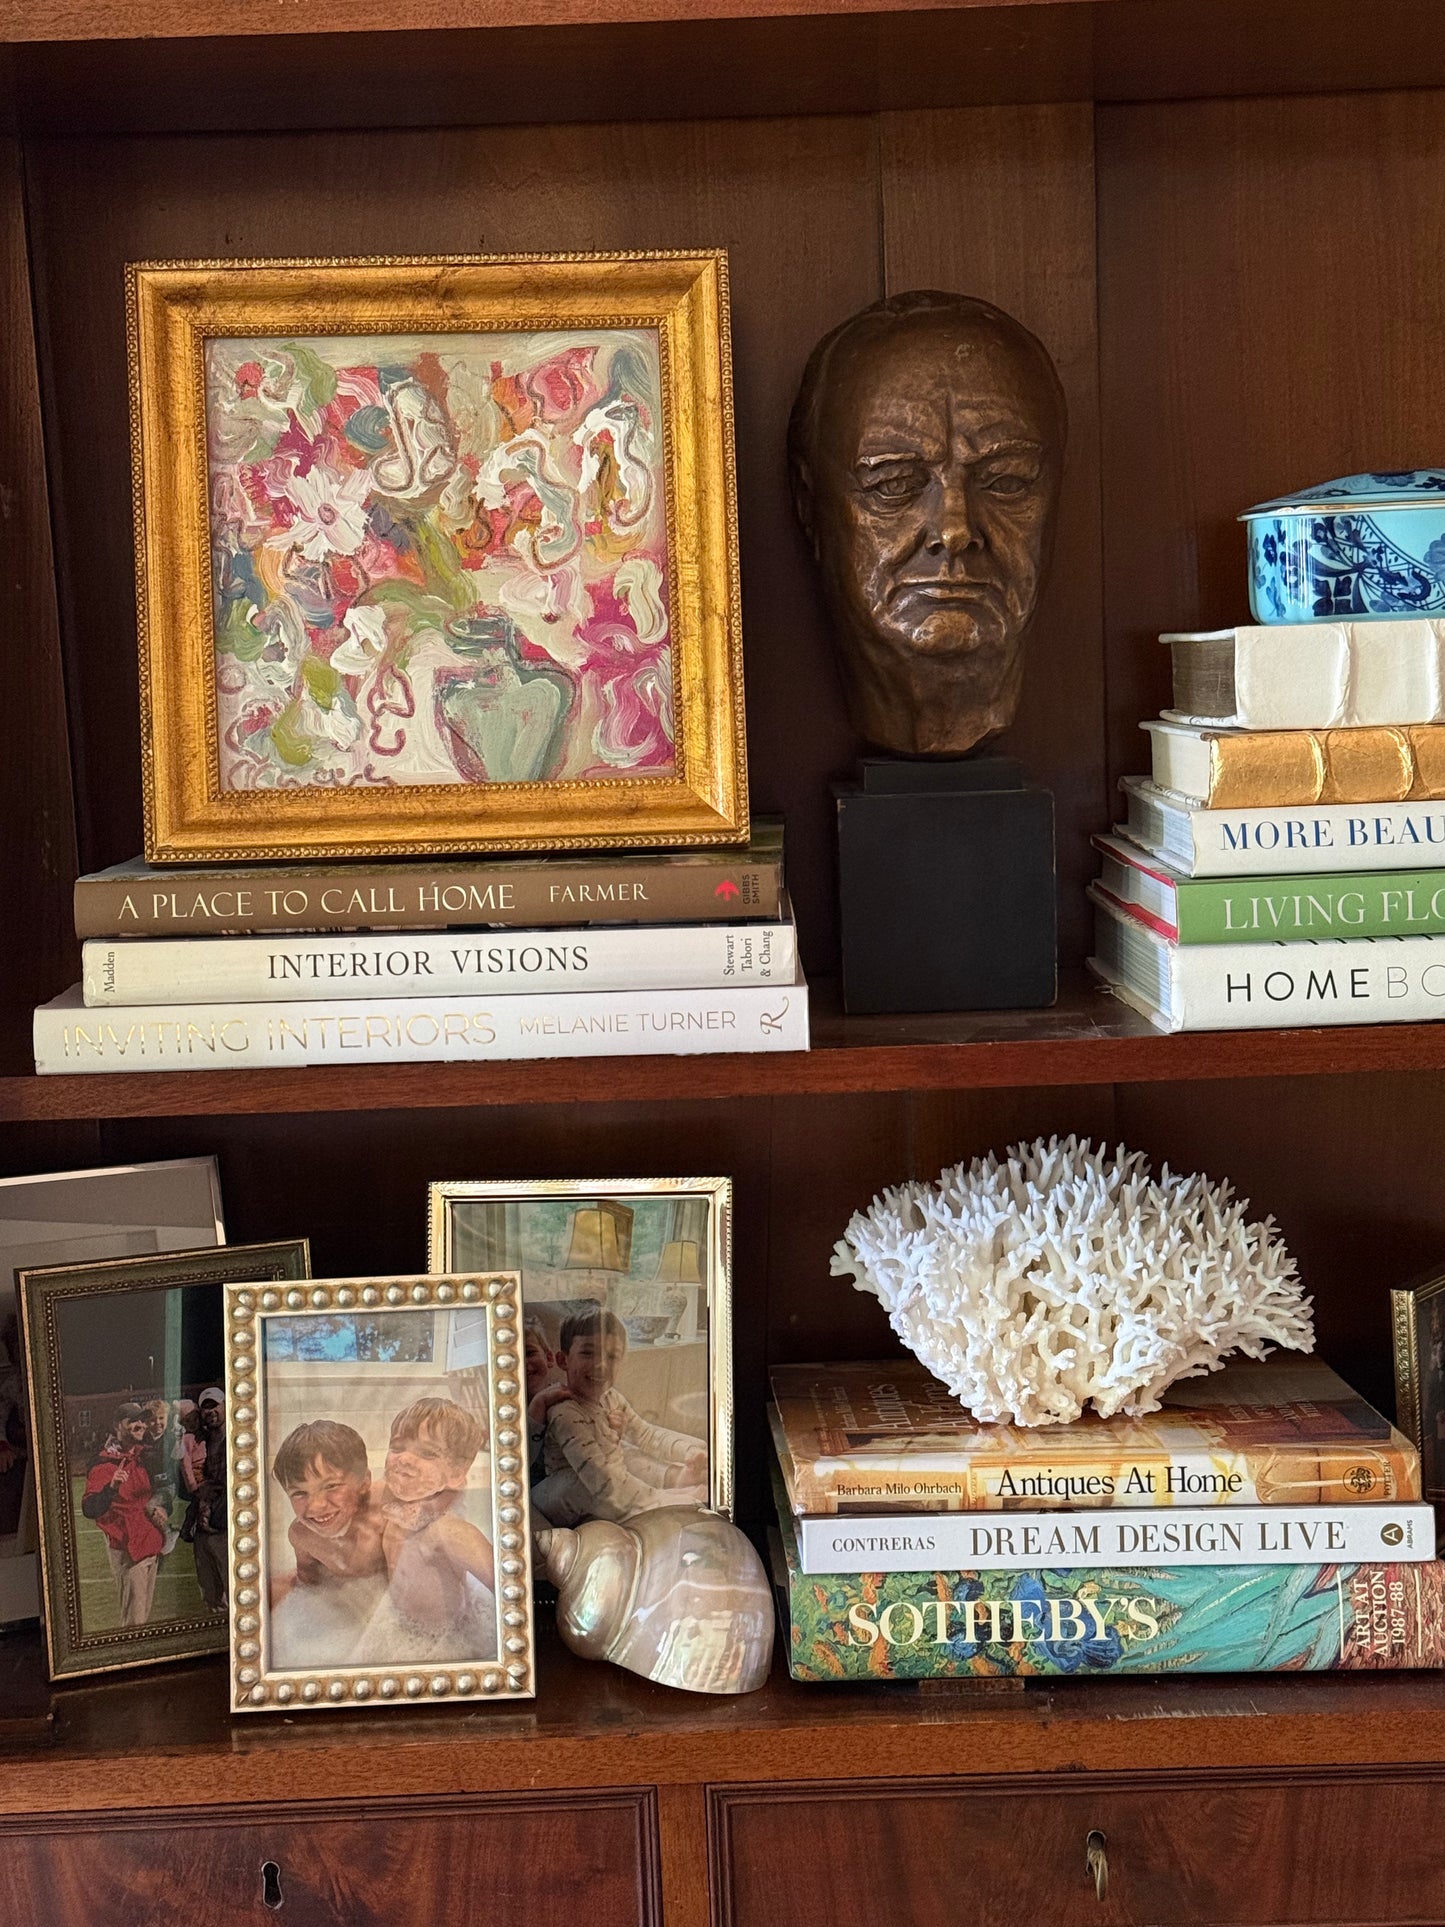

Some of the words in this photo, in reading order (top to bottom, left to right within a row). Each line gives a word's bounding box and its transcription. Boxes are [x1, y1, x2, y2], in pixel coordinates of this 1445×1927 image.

[1219, 818, 1334, 851] MORE
[1346, 815, 1445, 847] BEAU
[118, 894, 140, 920] A
[152, 891, 254, 919] PLACE
[264, 889, 308, 916] TO
[320, 887, 405, 914] CALL
[418, 884, 516, 912] HOME
[548, 882, 650, 903] FARMER
[742, 874, 750, 904] GIBBS
[752, 873, 760, 904] SMITH
[1224, 892, 1365, 930] LIVING
[268, 949, 435, 979] INTERIOR
[451, 946, 589, 974] VISIONS
[723, 934, 735, 976] Stewart
[740, 937, 753, 972] Tabori
[758, 930, 774, 966] Chang
[103, 951, 116, 993] Madden
[760, 967, 771, 977] &
[63, 1020, 250, 1057] INVITING
[267, 1012, 496, 1051] INTERIORS
[519, 1014, 629, 1036] MELANIE
[636, 1010, 736, 1032] TURNER
[836, 1484, 882, 1497] Barbara
[885, 1483, 911, 1496] Milo
[913, 1482, 962, 1495] Ohrbach
[994, 1468, 1115, 1500] Antiques
[1124, 1467, 1156, 1494] At
[1164, 1466, 1243, 1493] Home
[1383, 1461, 1392, 1497] POTTER
[831, 1536, 936, 1553] CONTRERAS
[969, 1525, 1103, 1556] DREAM
[1116, 1523, 1244, 1553] DESIGN
[1257, 1521, 1347, 1551] LIVE
[1352, 1579, 1368, 1606] AT
[847, 1597, 1159, 1646] SOTHEBY'S
[1353, 1610, 1371, 1651] ART
[1371, 1570, 1389, 1657] AUCTION
